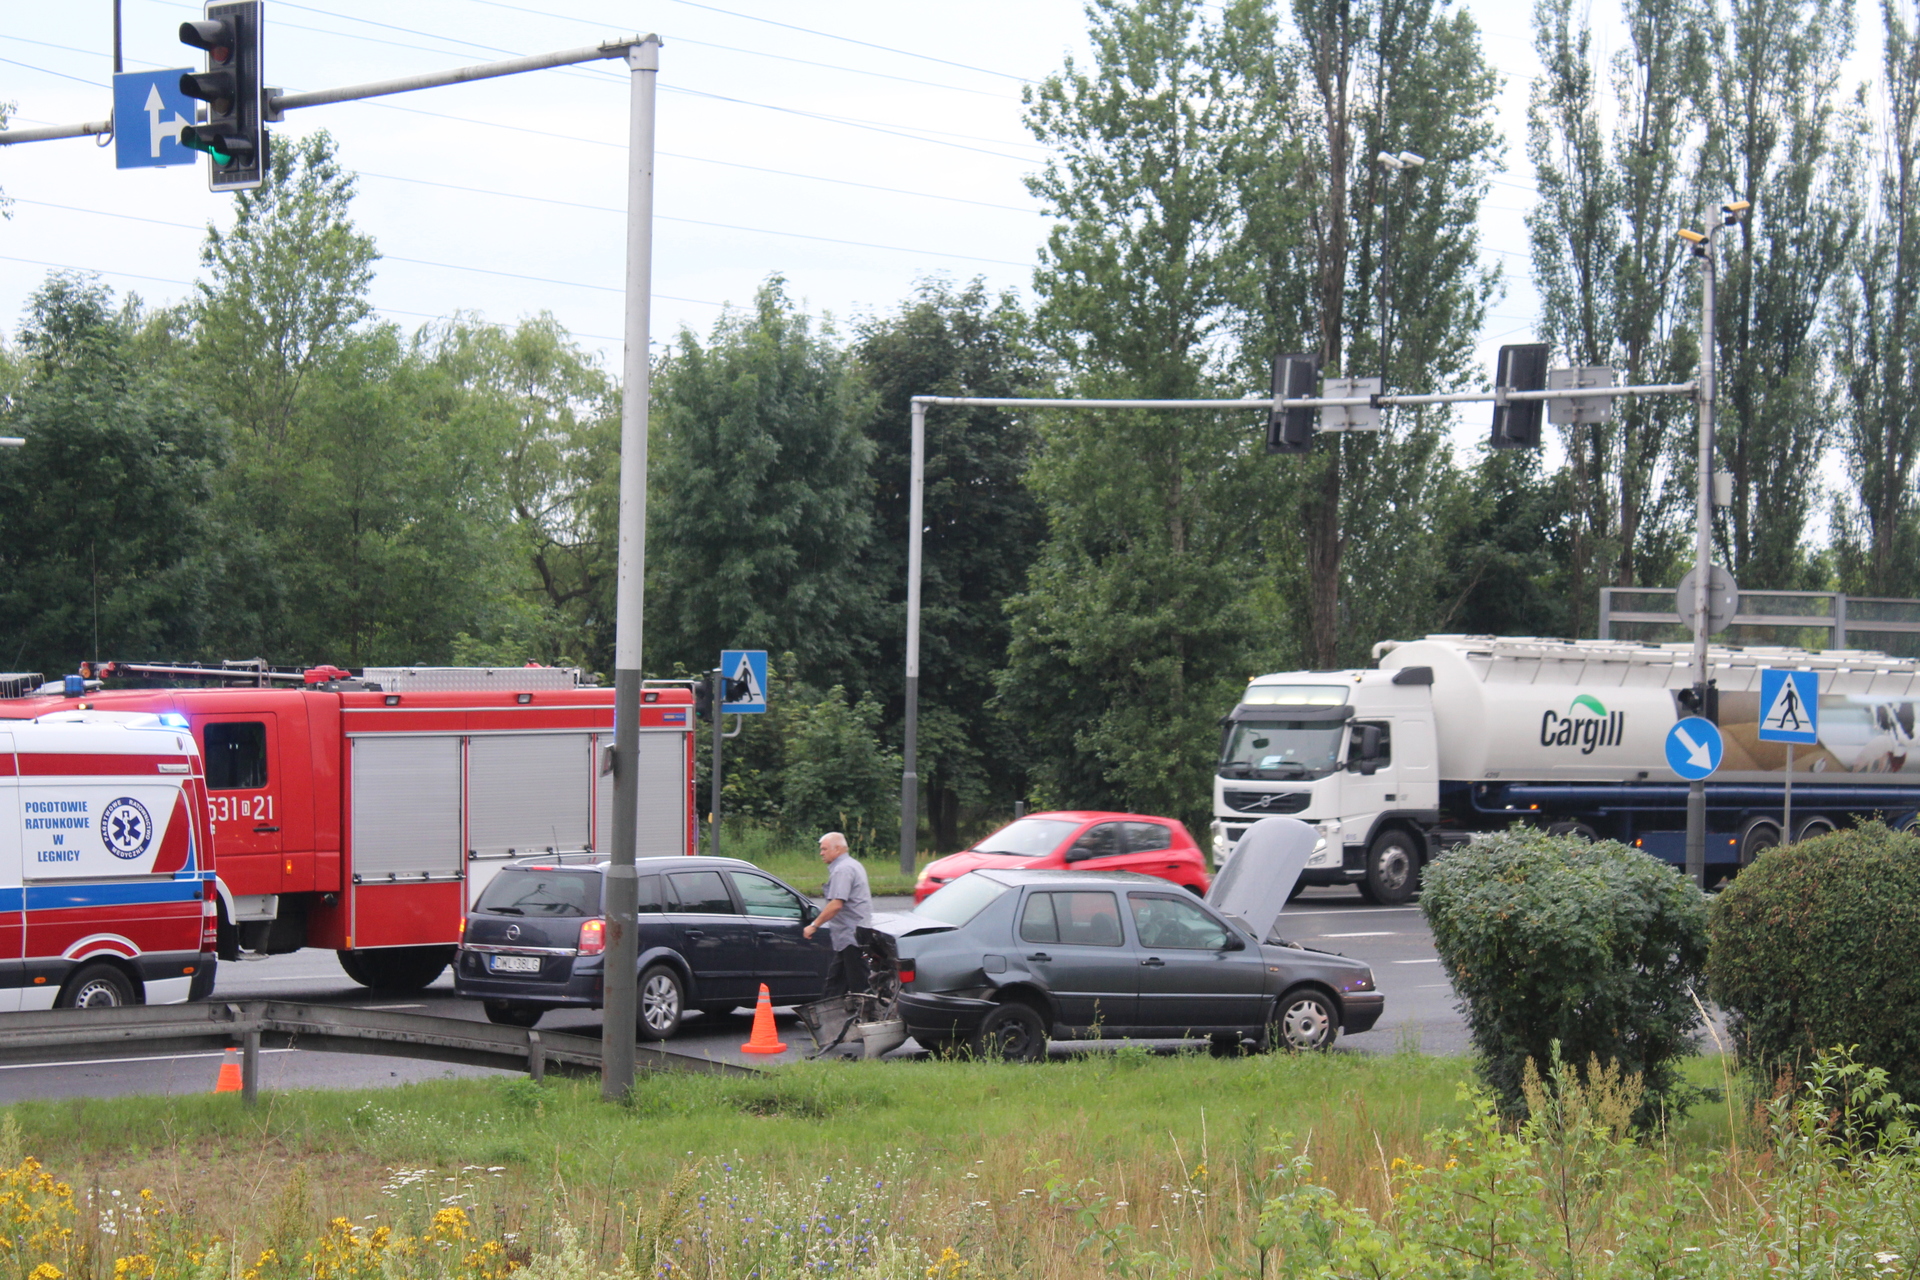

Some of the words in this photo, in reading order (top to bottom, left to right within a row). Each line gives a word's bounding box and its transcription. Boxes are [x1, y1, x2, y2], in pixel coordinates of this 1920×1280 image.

[1540, 710, 1624, 755] Cargill
[25, 801, 88, 813] POGOTOWIE
[207, 796, 238, 822] 531
[253, 795, 274, 820] 21
[25, 817, 90, 829] RATUNKOWE
[52, 834, 64, 845] W
[37, 850, 80, 862] LEGNICY
[111, 845, 145, 858] MEDYCZNE
